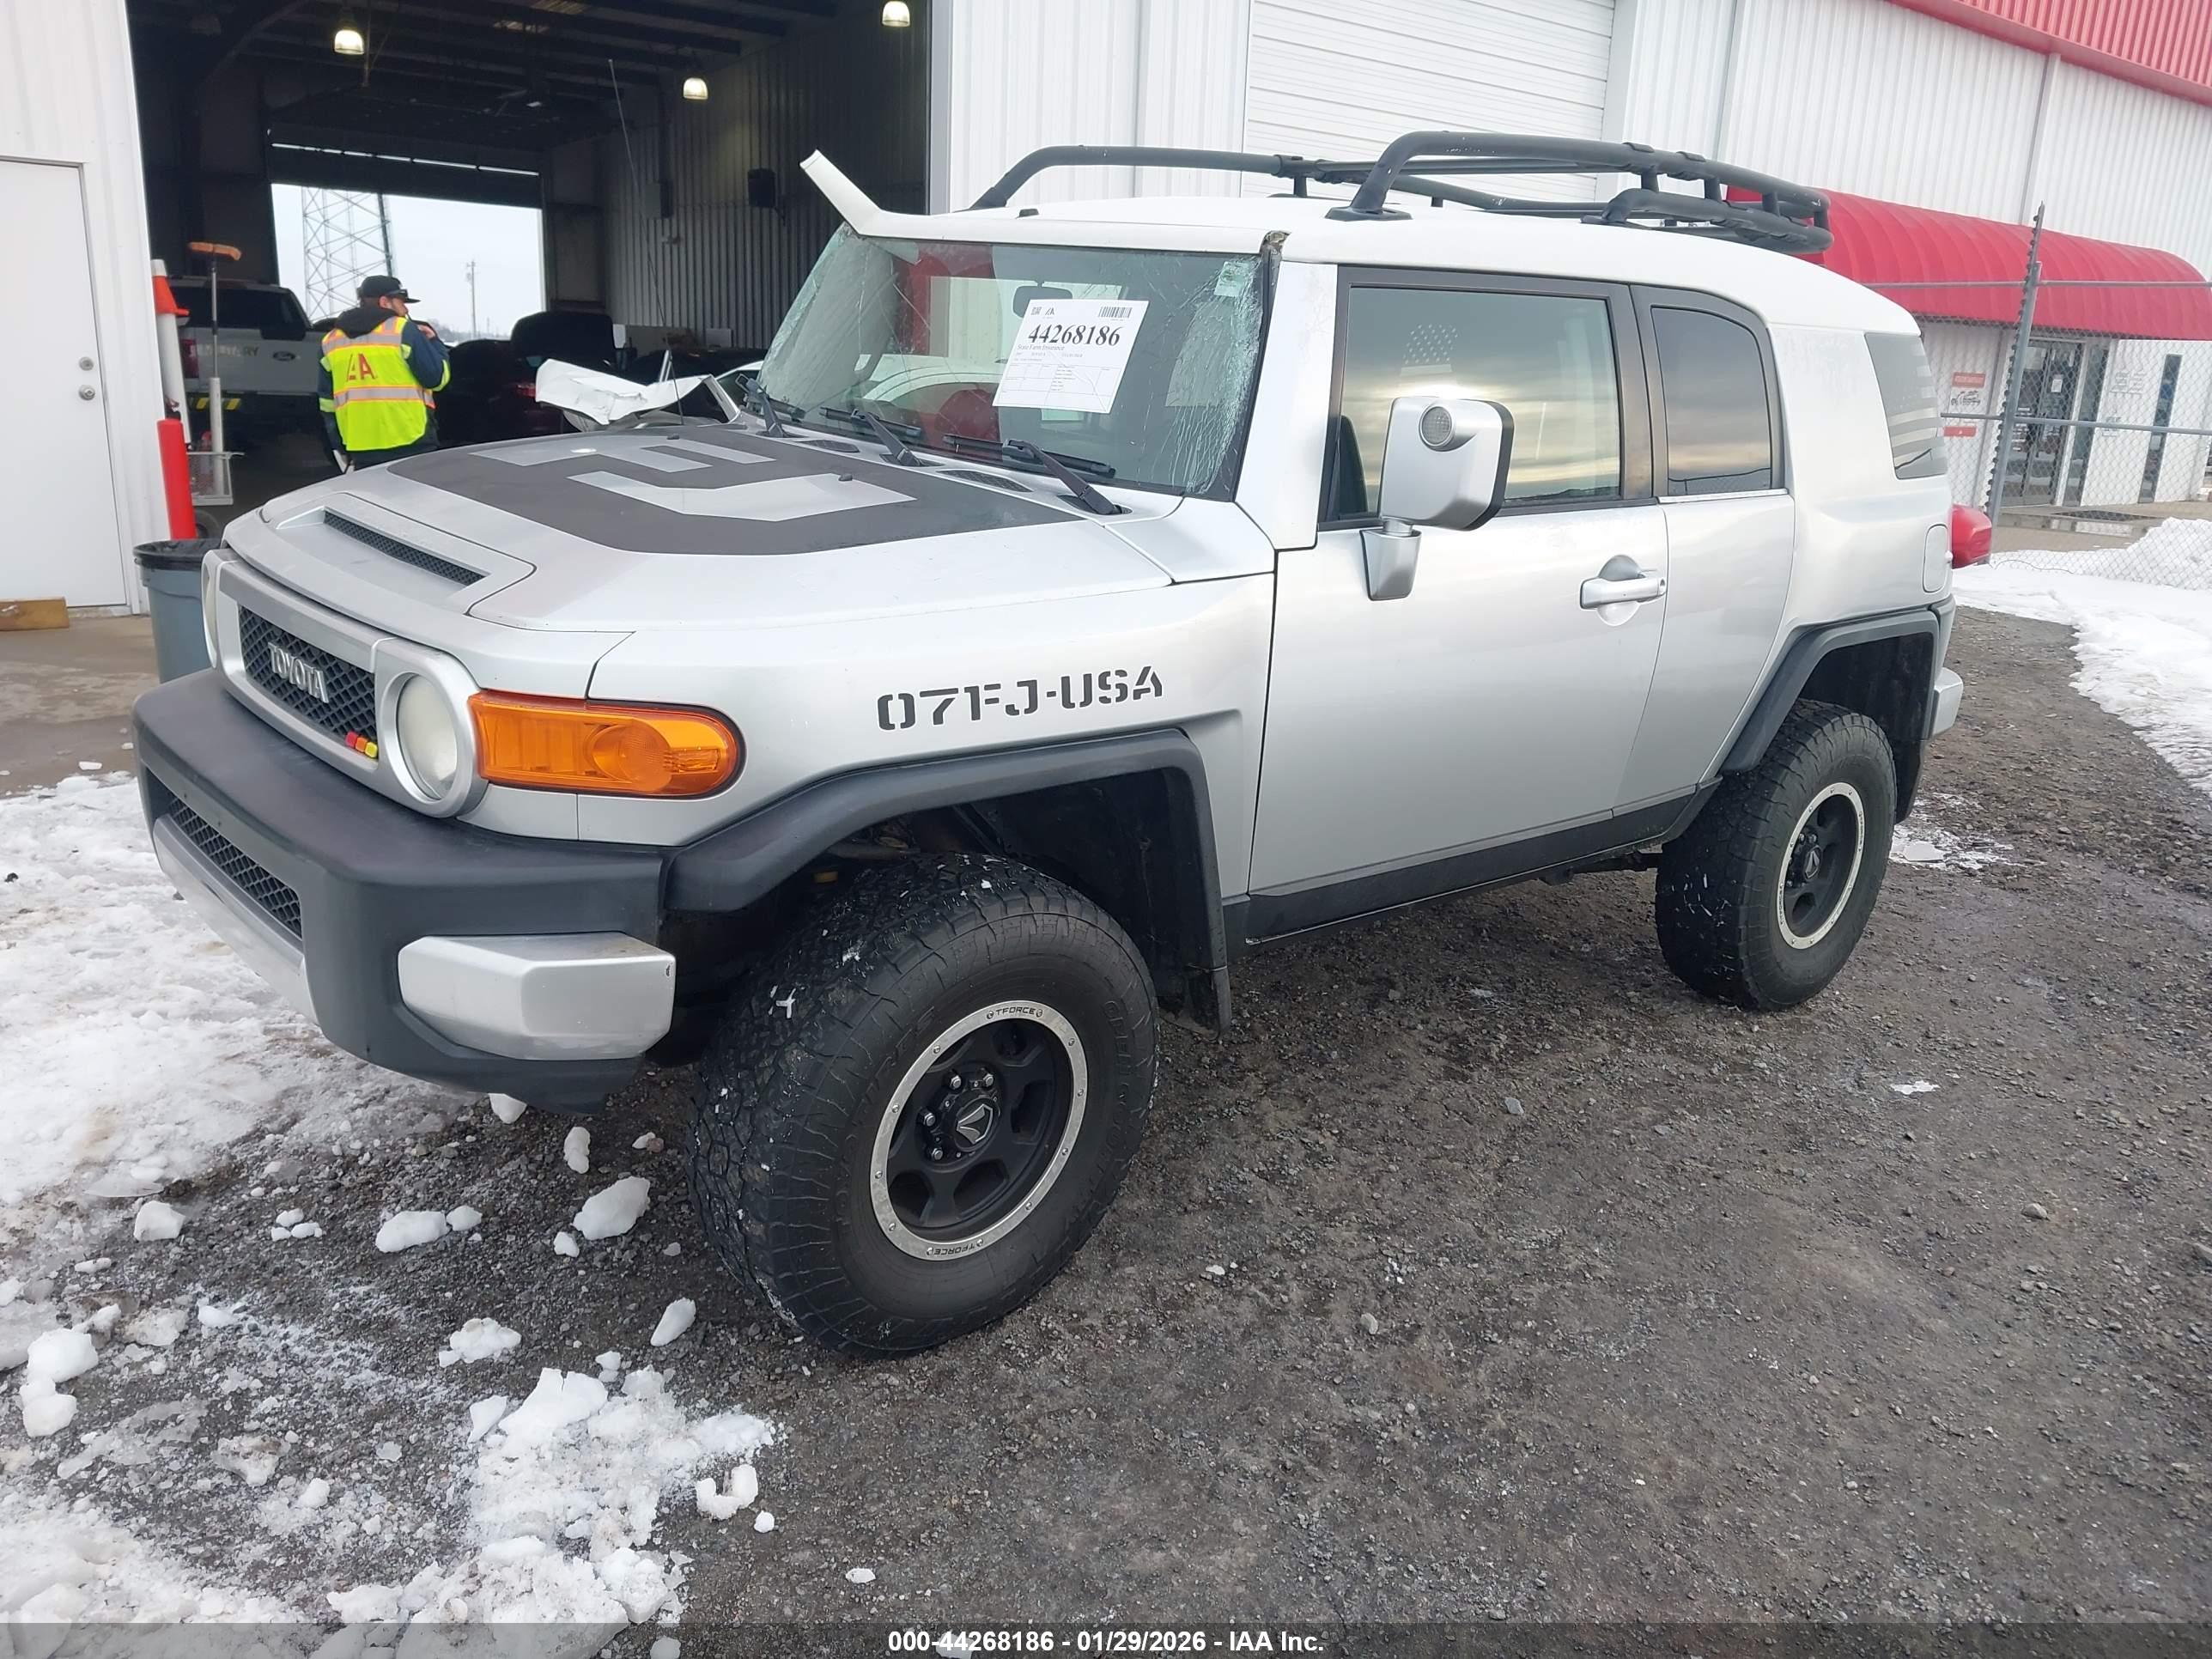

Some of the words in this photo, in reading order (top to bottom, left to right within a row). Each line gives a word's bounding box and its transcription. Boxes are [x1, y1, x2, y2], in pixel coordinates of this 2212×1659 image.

[1028, 324, 1124, 346] 44268186
[268, 641, 329, 703] TOYOTA
[877, 665, 1164, 732] 07FJ-USA
[995, 1006, 1036, 1016] TFORCE
[934, 1243, 975, 1255] TFORCE
